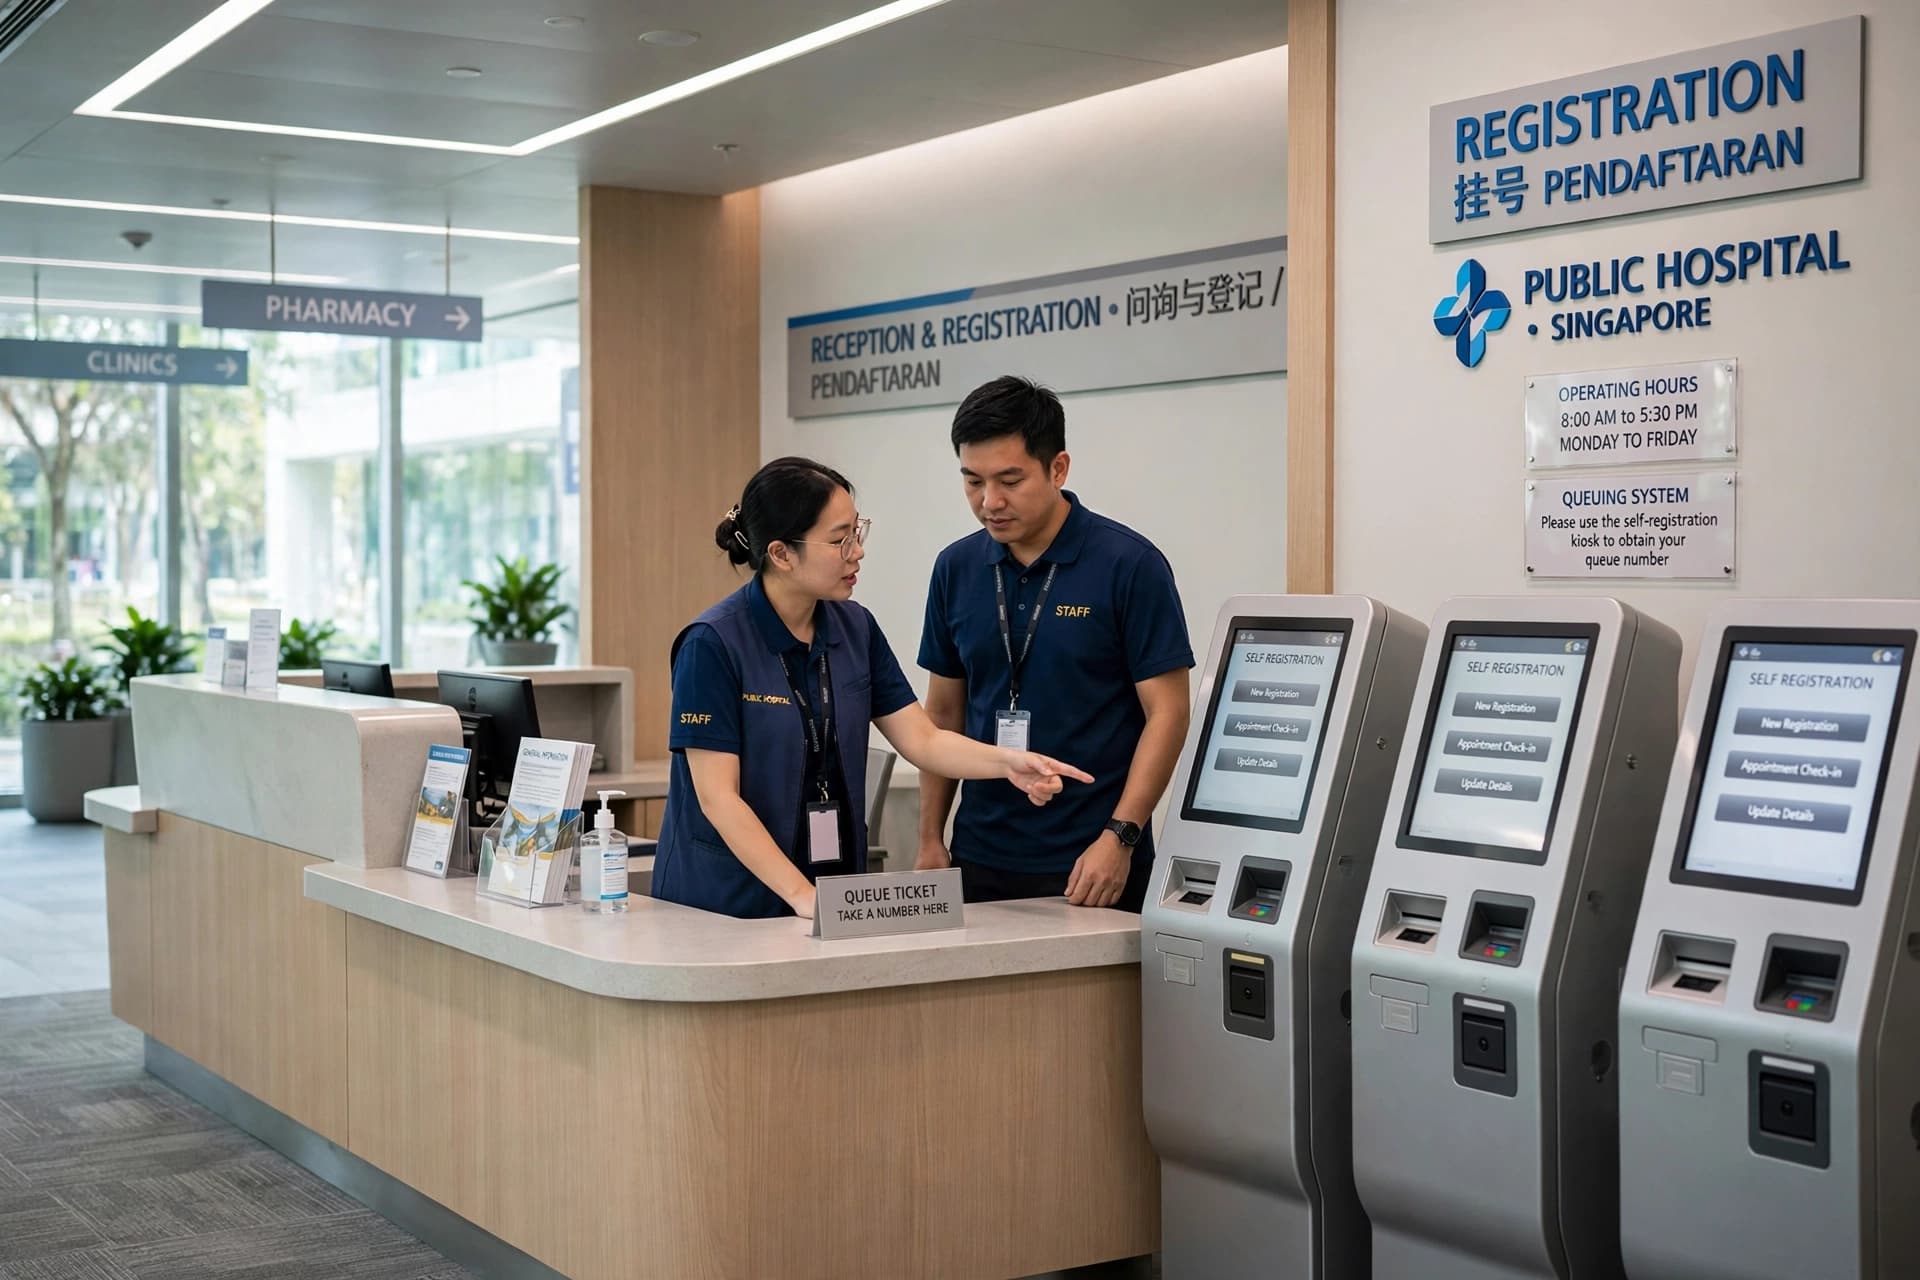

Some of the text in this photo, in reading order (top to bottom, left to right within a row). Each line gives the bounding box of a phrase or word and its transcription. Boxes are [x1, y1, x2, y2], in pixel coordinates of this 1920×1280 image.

[1456, 48, 1804, 163] REGISTRATION
[1454, 126, 1803, 223] 挂号 PENDAFTARAN
[1524, 230, 1850, 305] PUBLIC HOSPITAL
[266, 295, 416, 328] PHARMACY
[811, 323, 914, 363] RECEPTION
[922, 321, 936, 348] &
[943, 296, 1100, 346] REGISTRATION
[1127, 270, 1262, 325] 问询与登记
[1551, 297, 1711, 341] SINGAPORE
[87, 350, 178, 377] CLINICS
[811, 359, 940, 400] PENDAFTARAN
[1559, 376, 1698, 402] OPERATING HOURS
[1561, 403, 1698, 428] 8:00 AM to 5:30 PM
[1560, 429, 1698, 452] MONDAY TO FRIDAY
[1562, 487, 1689, 509] QUEUING SYSTEM
[1541, 512, 1718, 530] Please use the self-registration
[1571, 531, 1686, 550] kiosk to obtain your
[1585, 551, 1669, 570] queue number
[1055, 605, 1091, 617] STAFF
[1245, 652, 1325, 665] SELF REGISTRATION
[1467, 661, 1565, 677] SELF REGISTRATION
[1749, 672, 1874, 690] SELF REGISTRATION
[1250, 687, 1264, 697] New
[1475, 701, 1537, 715] New Registration
[680, 713, 712, 725] STAFF
[1761, 717, 1840, 734] New Registration
[1457, 738, 1502, 752] Appointment
[1740, 759, 1842, 778] Appointment Check-in
[1461, 777, 1513, 792] Update Details
[1747, 805, 1815, 822] Update Details
[844, 884, 937, 905] QUEUE TICKET
[837, 902, 949, 922] TAKE A NUMBER HERE
